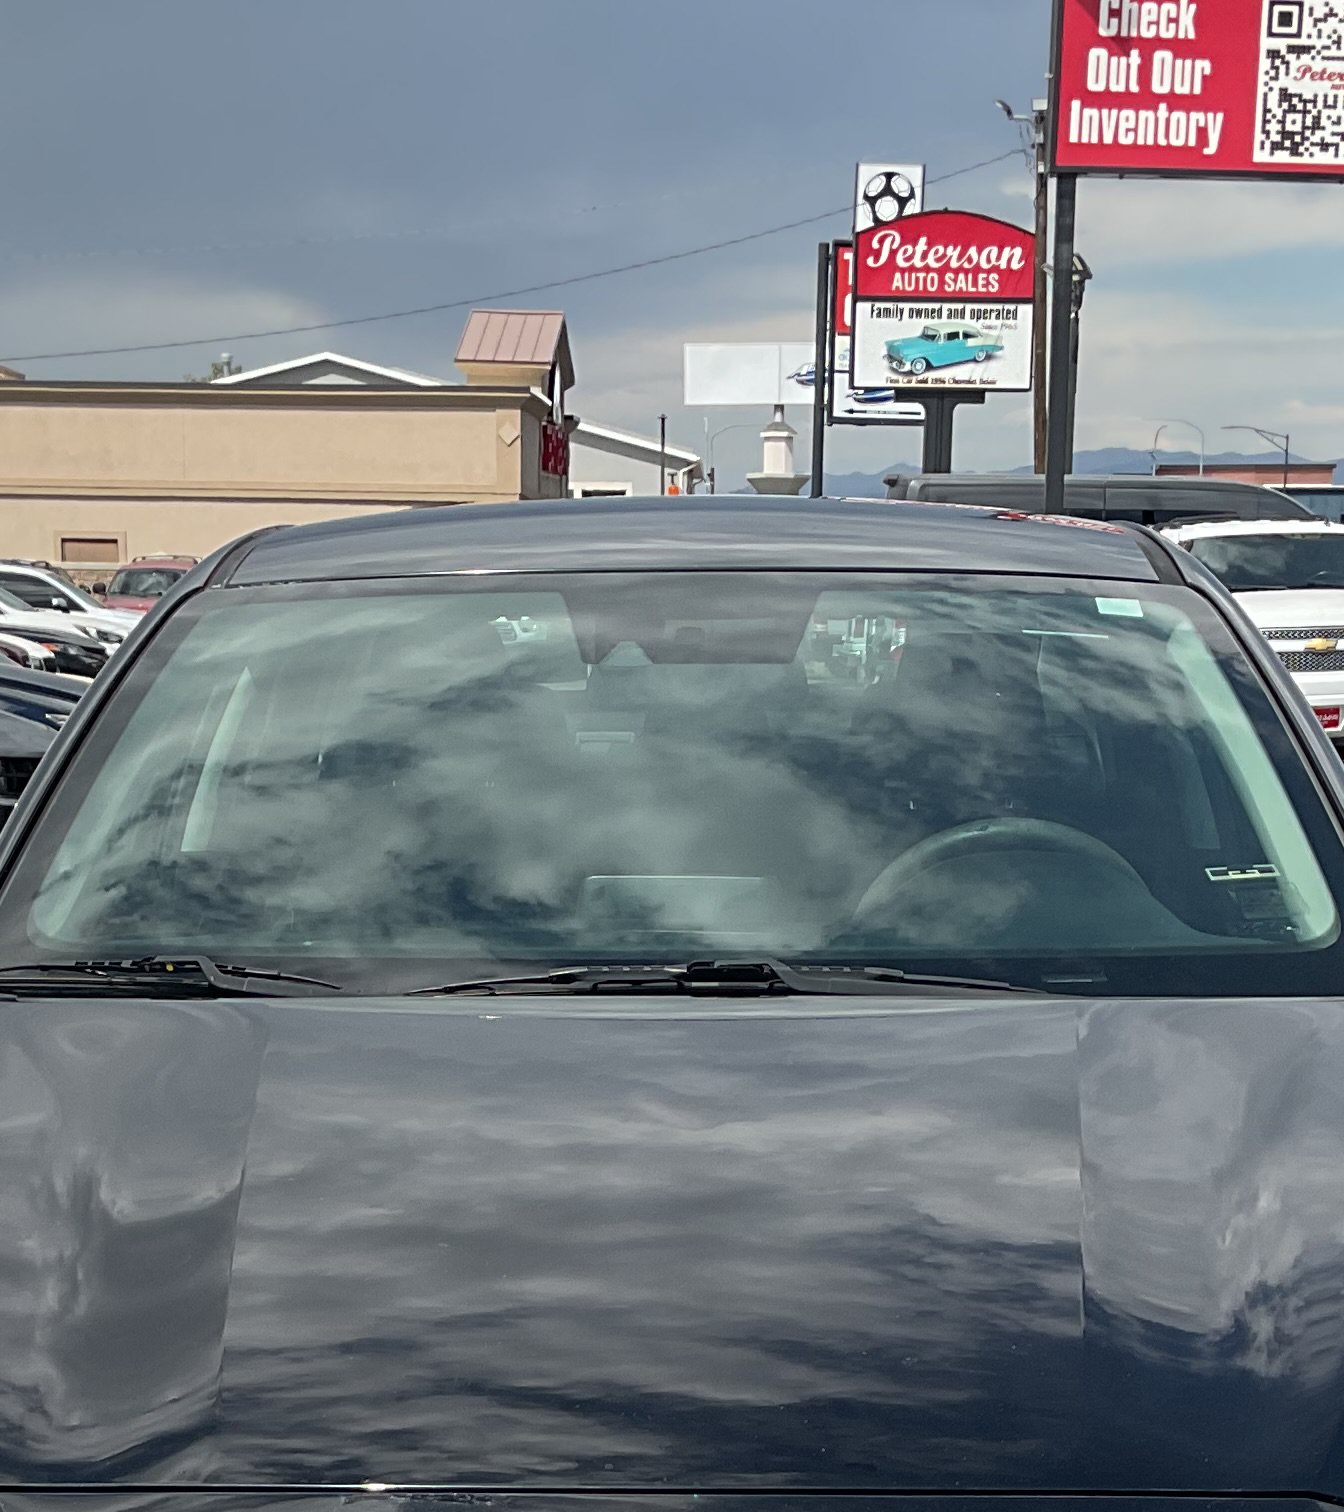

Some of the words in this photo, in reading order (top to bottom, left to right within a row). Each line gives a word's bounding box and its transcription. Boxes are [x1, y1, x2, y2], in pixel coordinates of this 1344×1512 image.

[1098, 0, 1197, 39] Check
[1087, 47, 1141, 93] Out
[1151, 50, 1212, 95] Our
[1069, 99, 1225, 155] Inventory
[866, 229, 1025, 270] Peterson
[892, 272, 938, 292] AUTO
[944, 272, 999, 293] SALES
[870, 303, 905, 321] Family
[908, 304, 943, 320] owned
[946, 304, 966, 320] and
[969, 305, 1019, 322] operated
